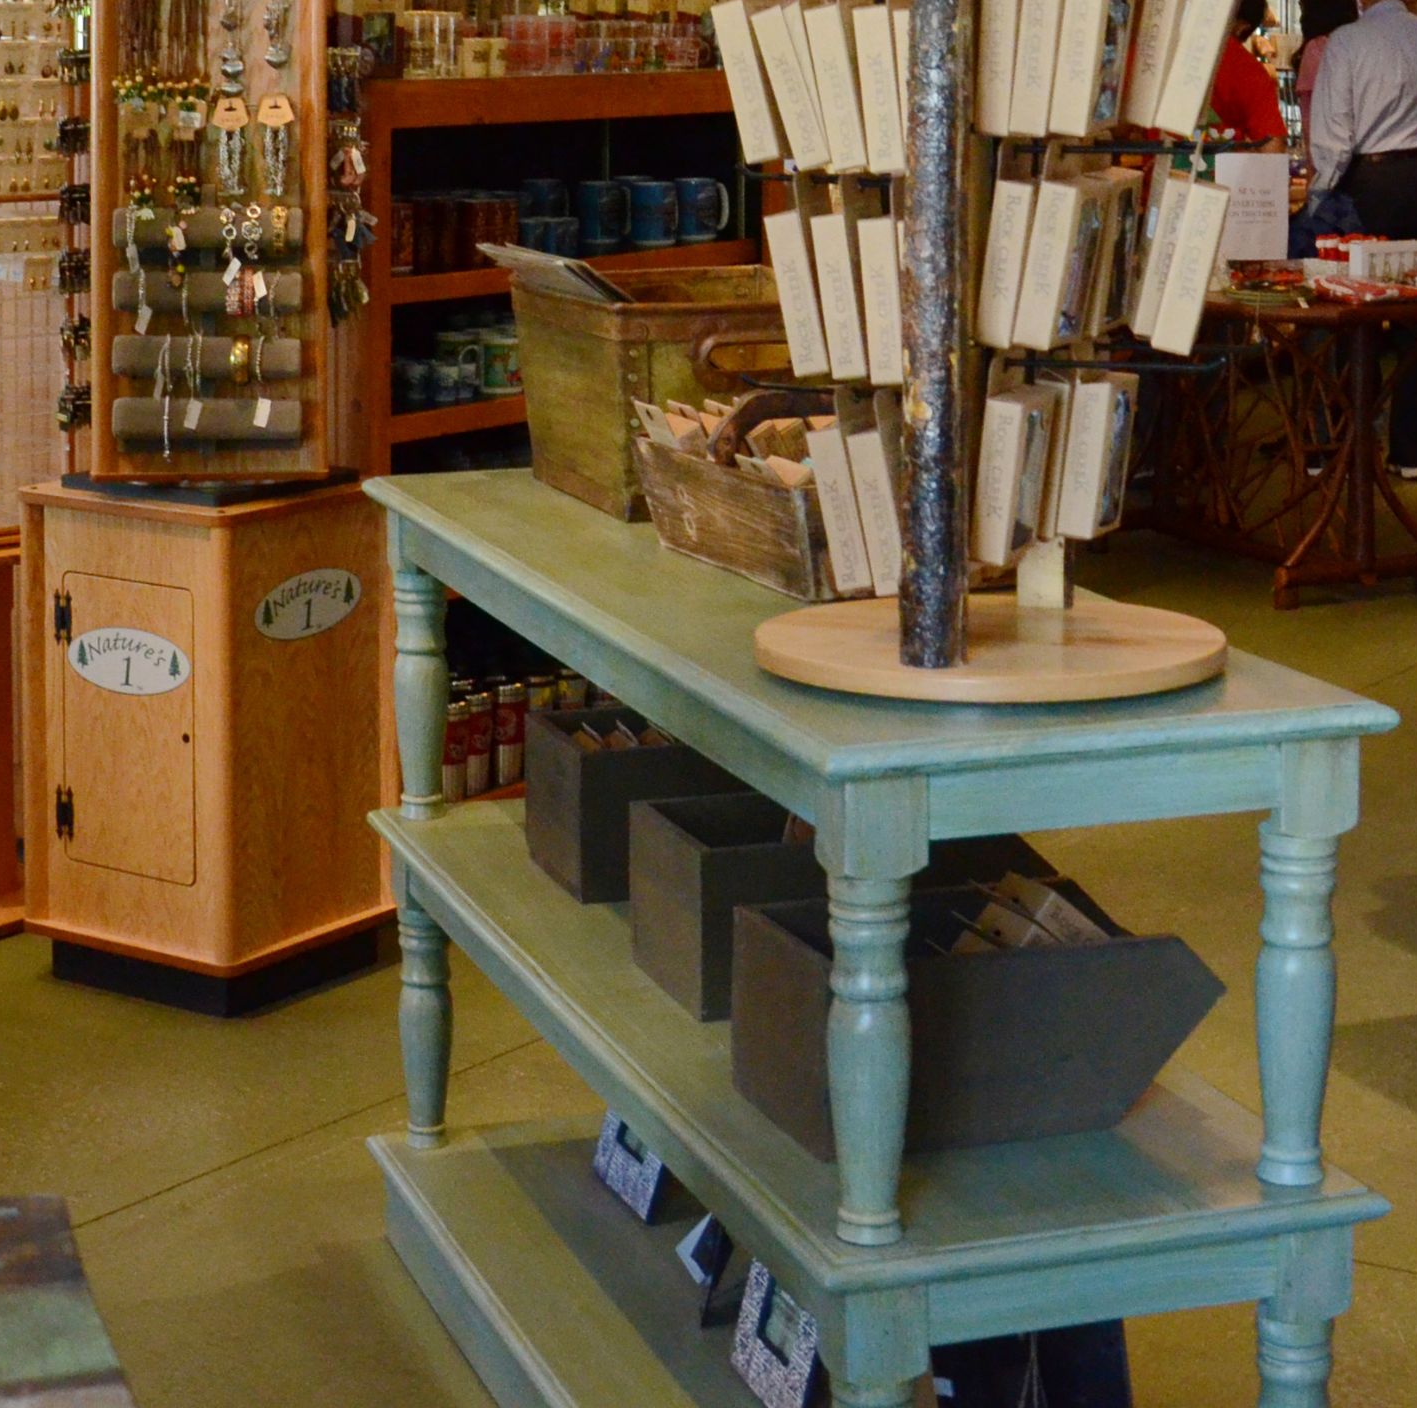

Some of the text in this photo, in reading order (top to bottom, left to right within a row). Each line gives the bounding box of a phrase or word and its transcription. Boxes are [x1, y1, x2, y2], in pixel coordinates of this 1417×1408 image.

[273, 578, 341, 617] Nature's
[301, 598, 314, 631] 1
[88, 632, 166, 667] Nature's
[121, 656, 132, 686] 1
